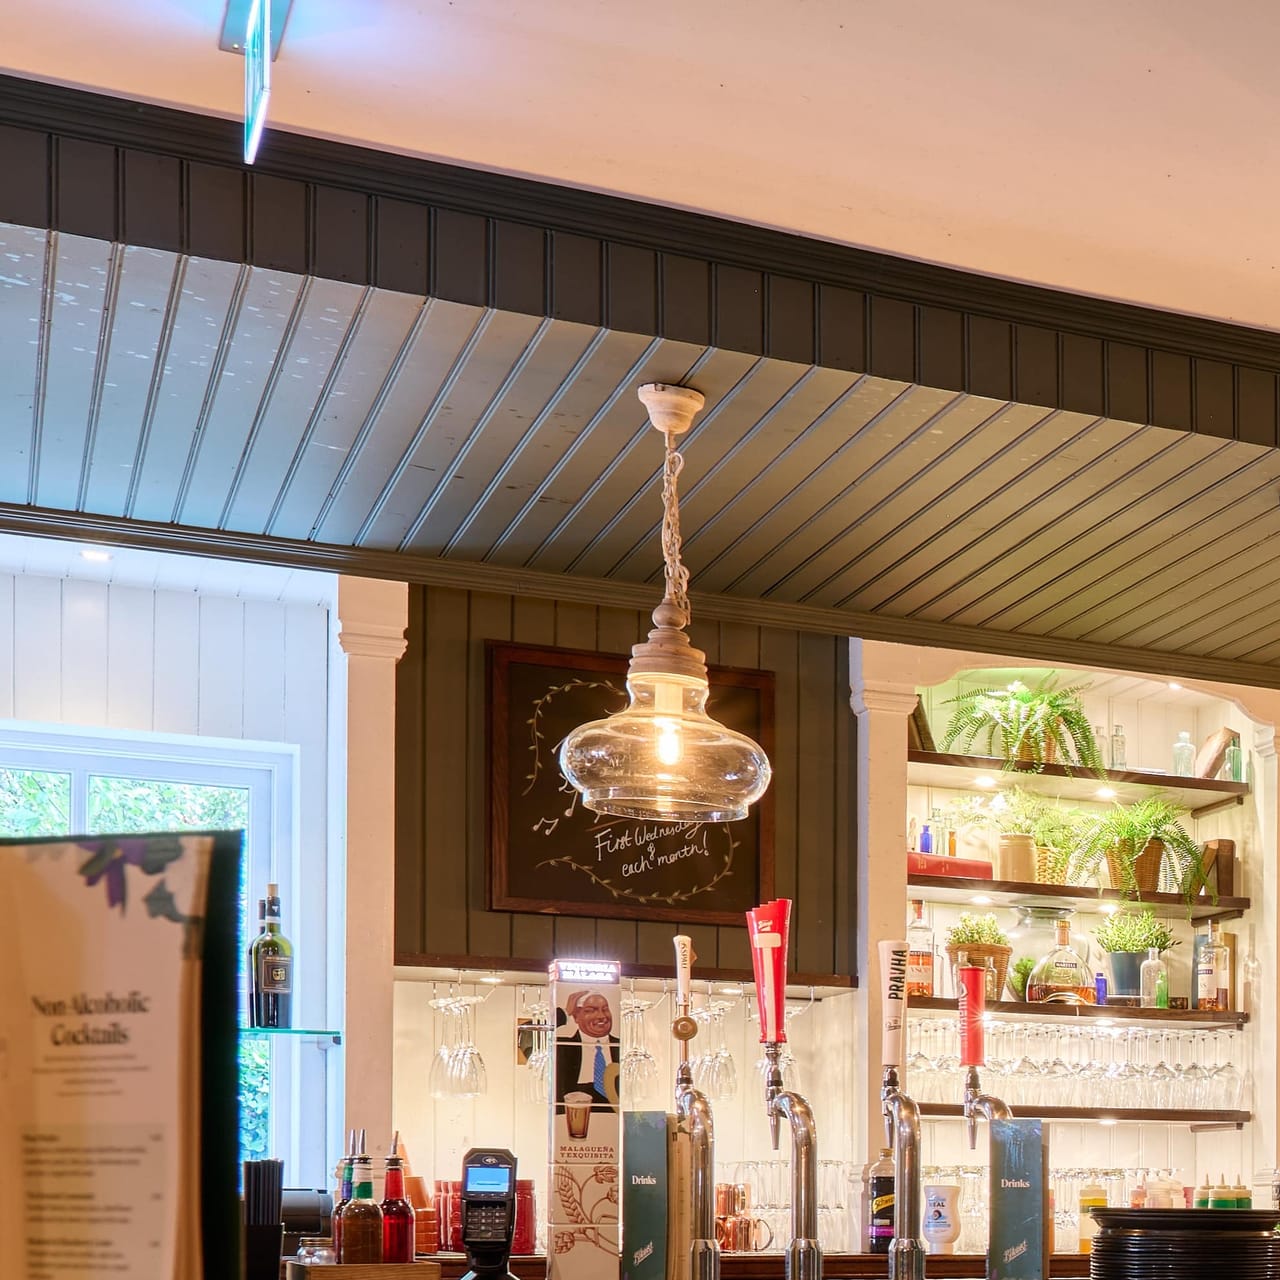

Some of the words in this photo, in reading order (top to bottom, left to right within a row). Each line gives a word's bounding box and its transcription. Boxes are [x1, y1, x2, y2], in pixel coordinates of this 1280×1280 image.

[595, 830, 633, 862] First
[635, 821, 704, 848] Wednesday
[622, 855, 654, 877] each
[887, 949, 907, 1000] PRAVHA
[51, 1022, 129, 1046] Cocktails
[632, 1175, 657, 1185] Drinks
[1001, 1178, 1030, 1188] Drinks
